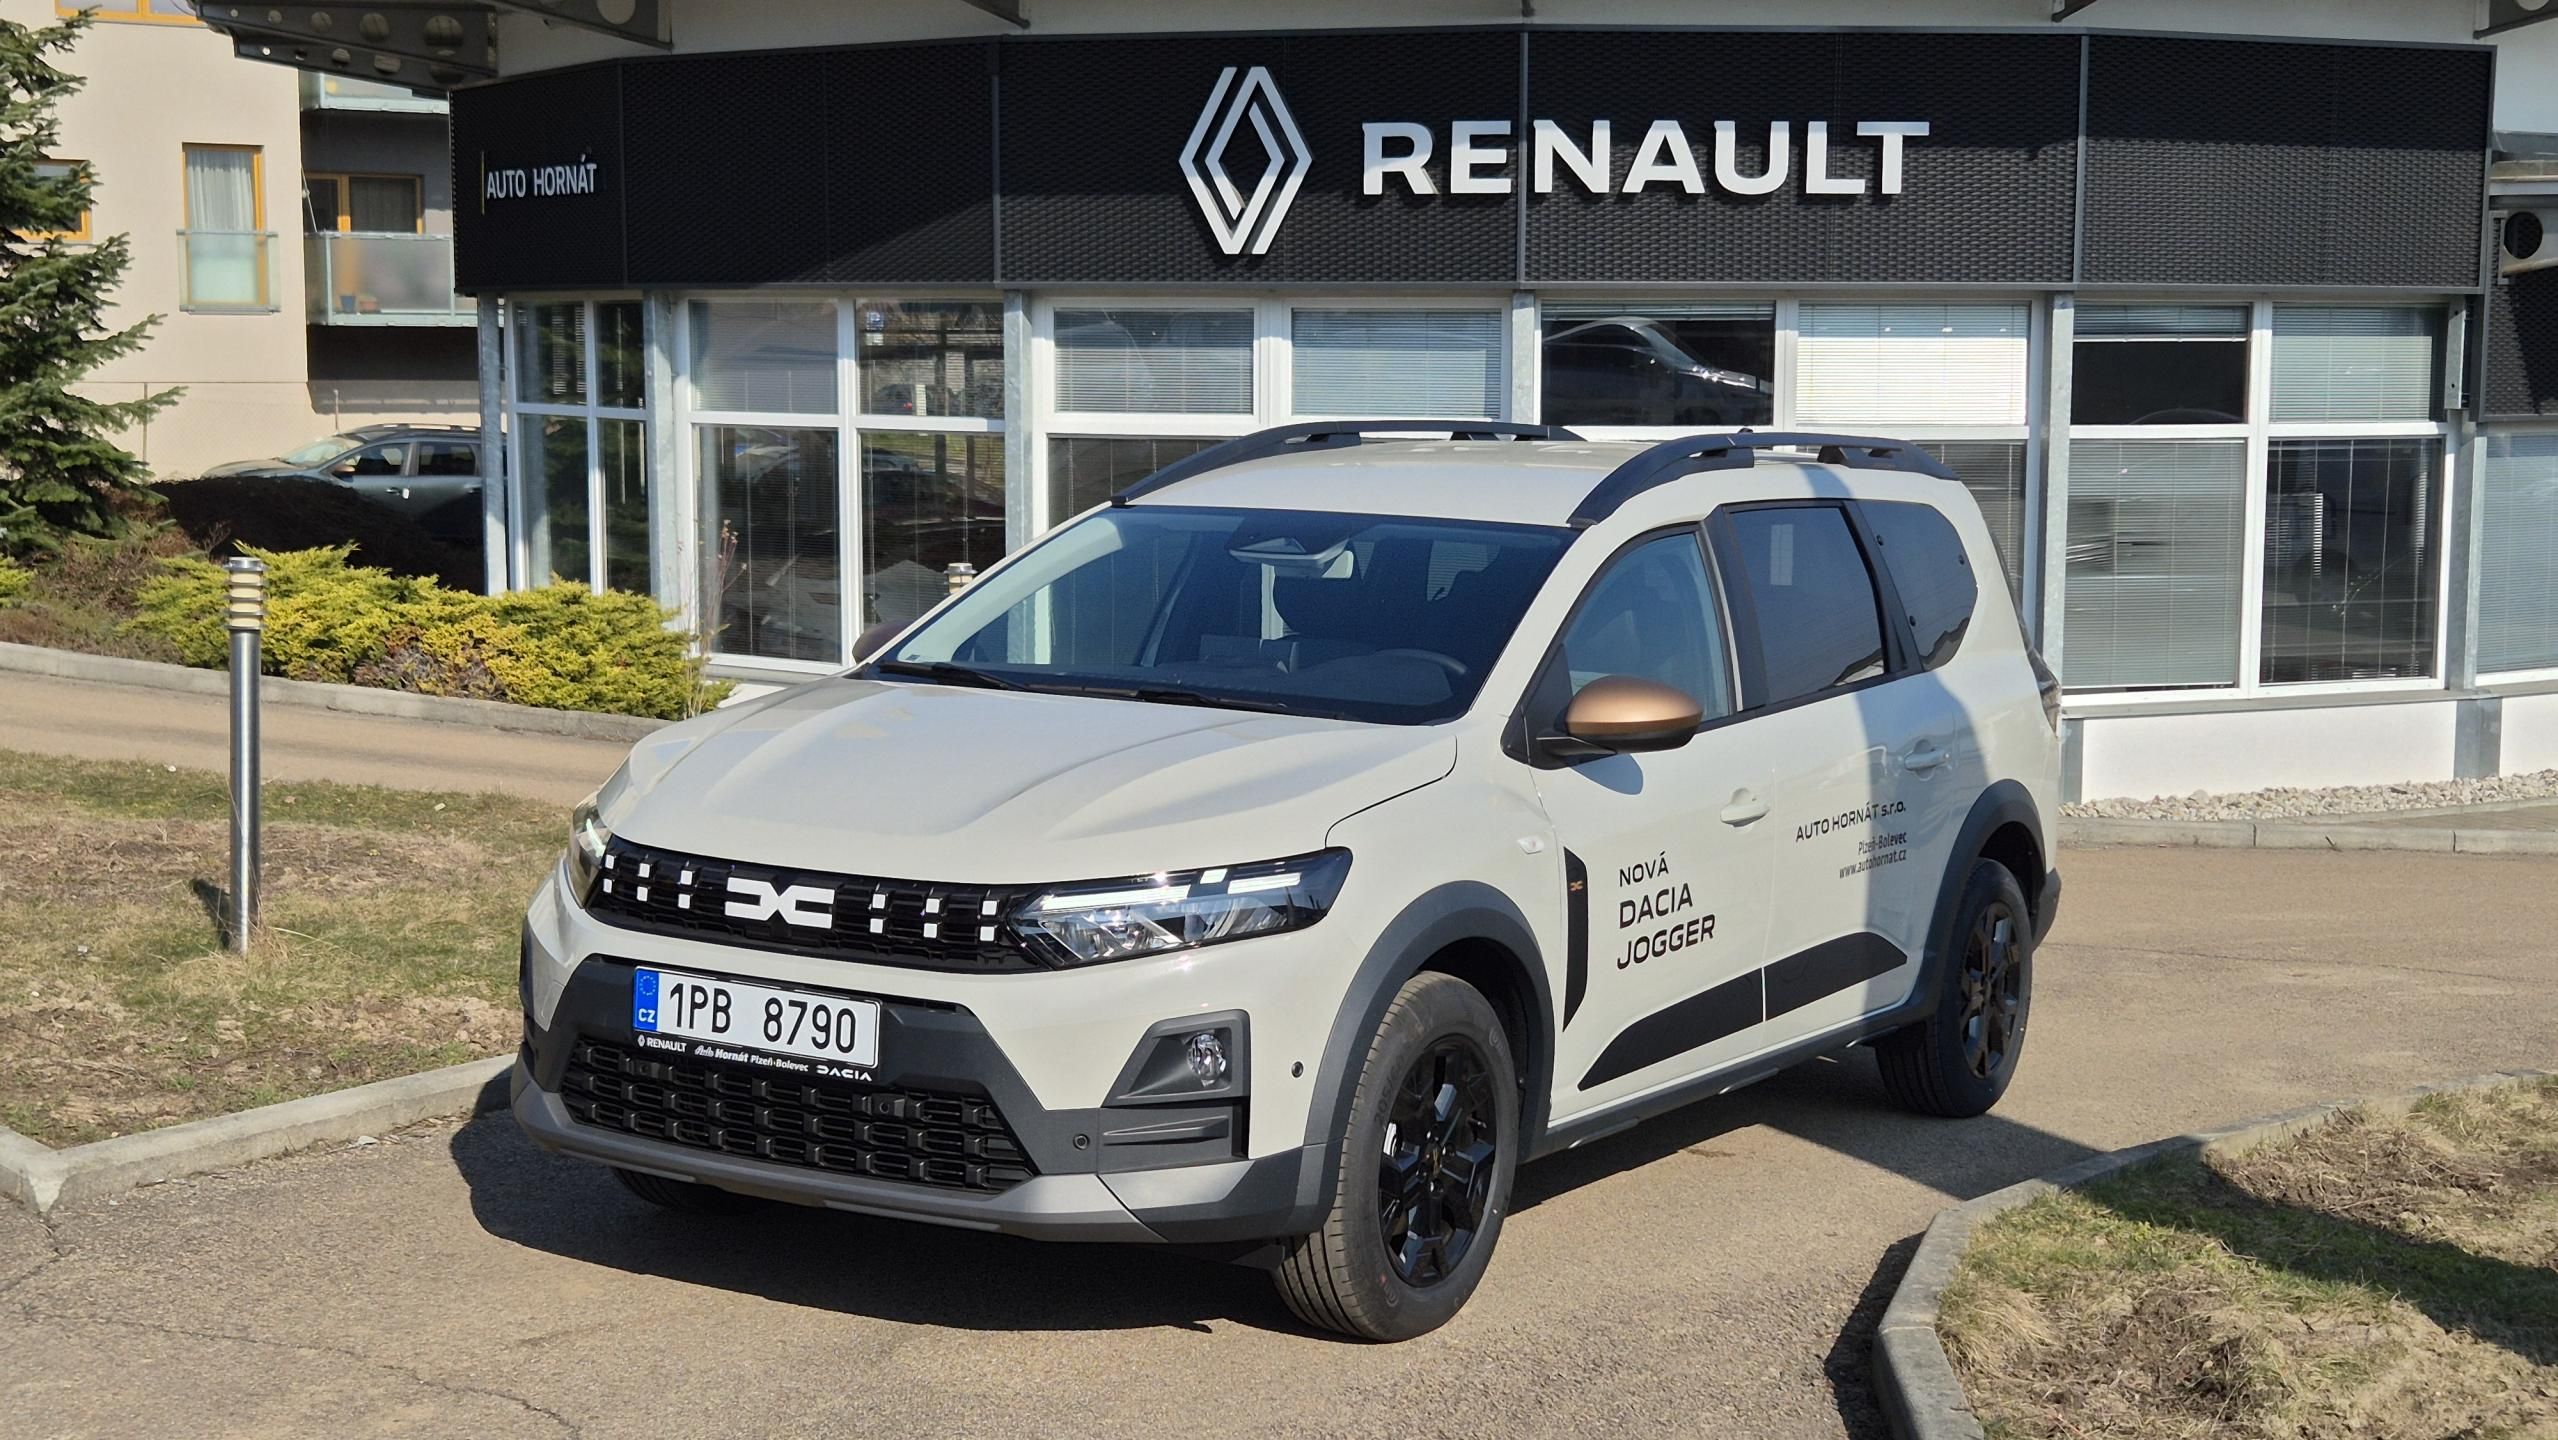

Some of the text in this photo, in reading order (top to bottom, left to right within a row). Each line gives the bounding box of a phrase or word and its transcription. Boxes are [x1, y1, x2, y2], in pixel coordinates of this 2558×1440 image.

[486, 154, 598, 199] AUTO HORNÁT
[1361, 119, 1930, 196] RENAULT
[1795, 801, 1906, 842] AUTO HORNÁT s.r.o.
[1858, 832, 1907, 855] Plzeň-Bolevec
[1619, 850, 1669, 888] NOVÁ
[1839, 849, 1907, 879] www.autohornat.cz
[1619, 882, 1693, 929] DACIA
[1616, 914, 1716, 970] JOGGER
[638, 1008, 656, 1024] CZ
[669, 982, 857, 1054] 1PB 8790
[646, 1037, 688, 1053] RENAULT
[714, 1048, 749, 1063] Hornát
[816, 1064, 873, 1082] DACIA
